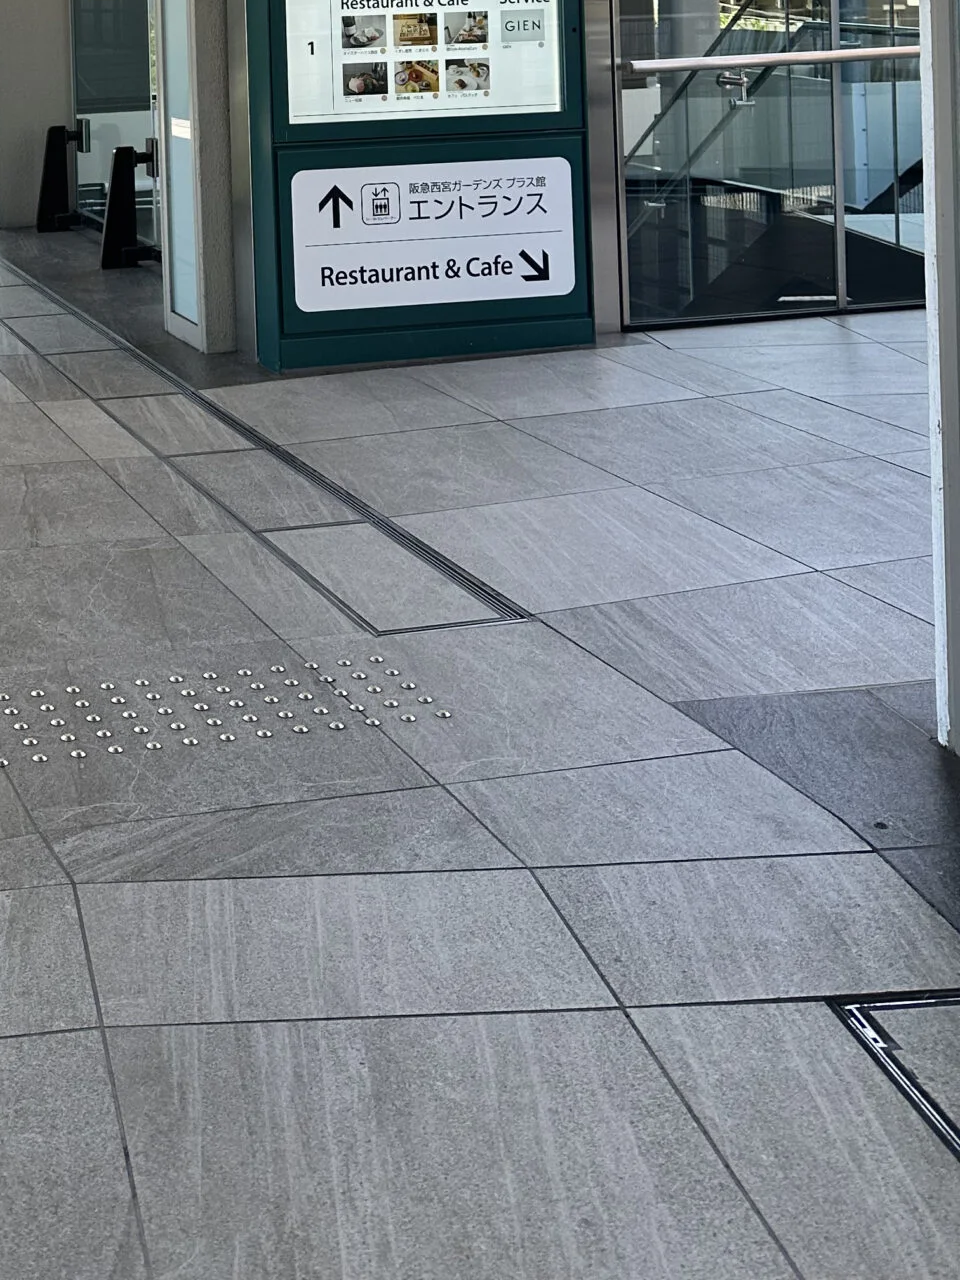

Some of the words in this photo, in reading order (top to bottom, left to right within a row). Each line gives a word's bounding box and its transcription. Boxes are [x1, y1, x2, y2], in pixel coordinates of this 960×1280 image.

[504, 19, 542, 33] GIEN
[307, 41, 316, 56] 1
[408, 177, 503, 194] 阪急西宮ガーデンズ
[506, 175, 546, 189] プラス館
[408, 192, 548, 221] エントランス
[320, 261, 439, 287] Restaurant
[444, 258, 461, 279] &
[466, 255, 513, 277] Cafe
